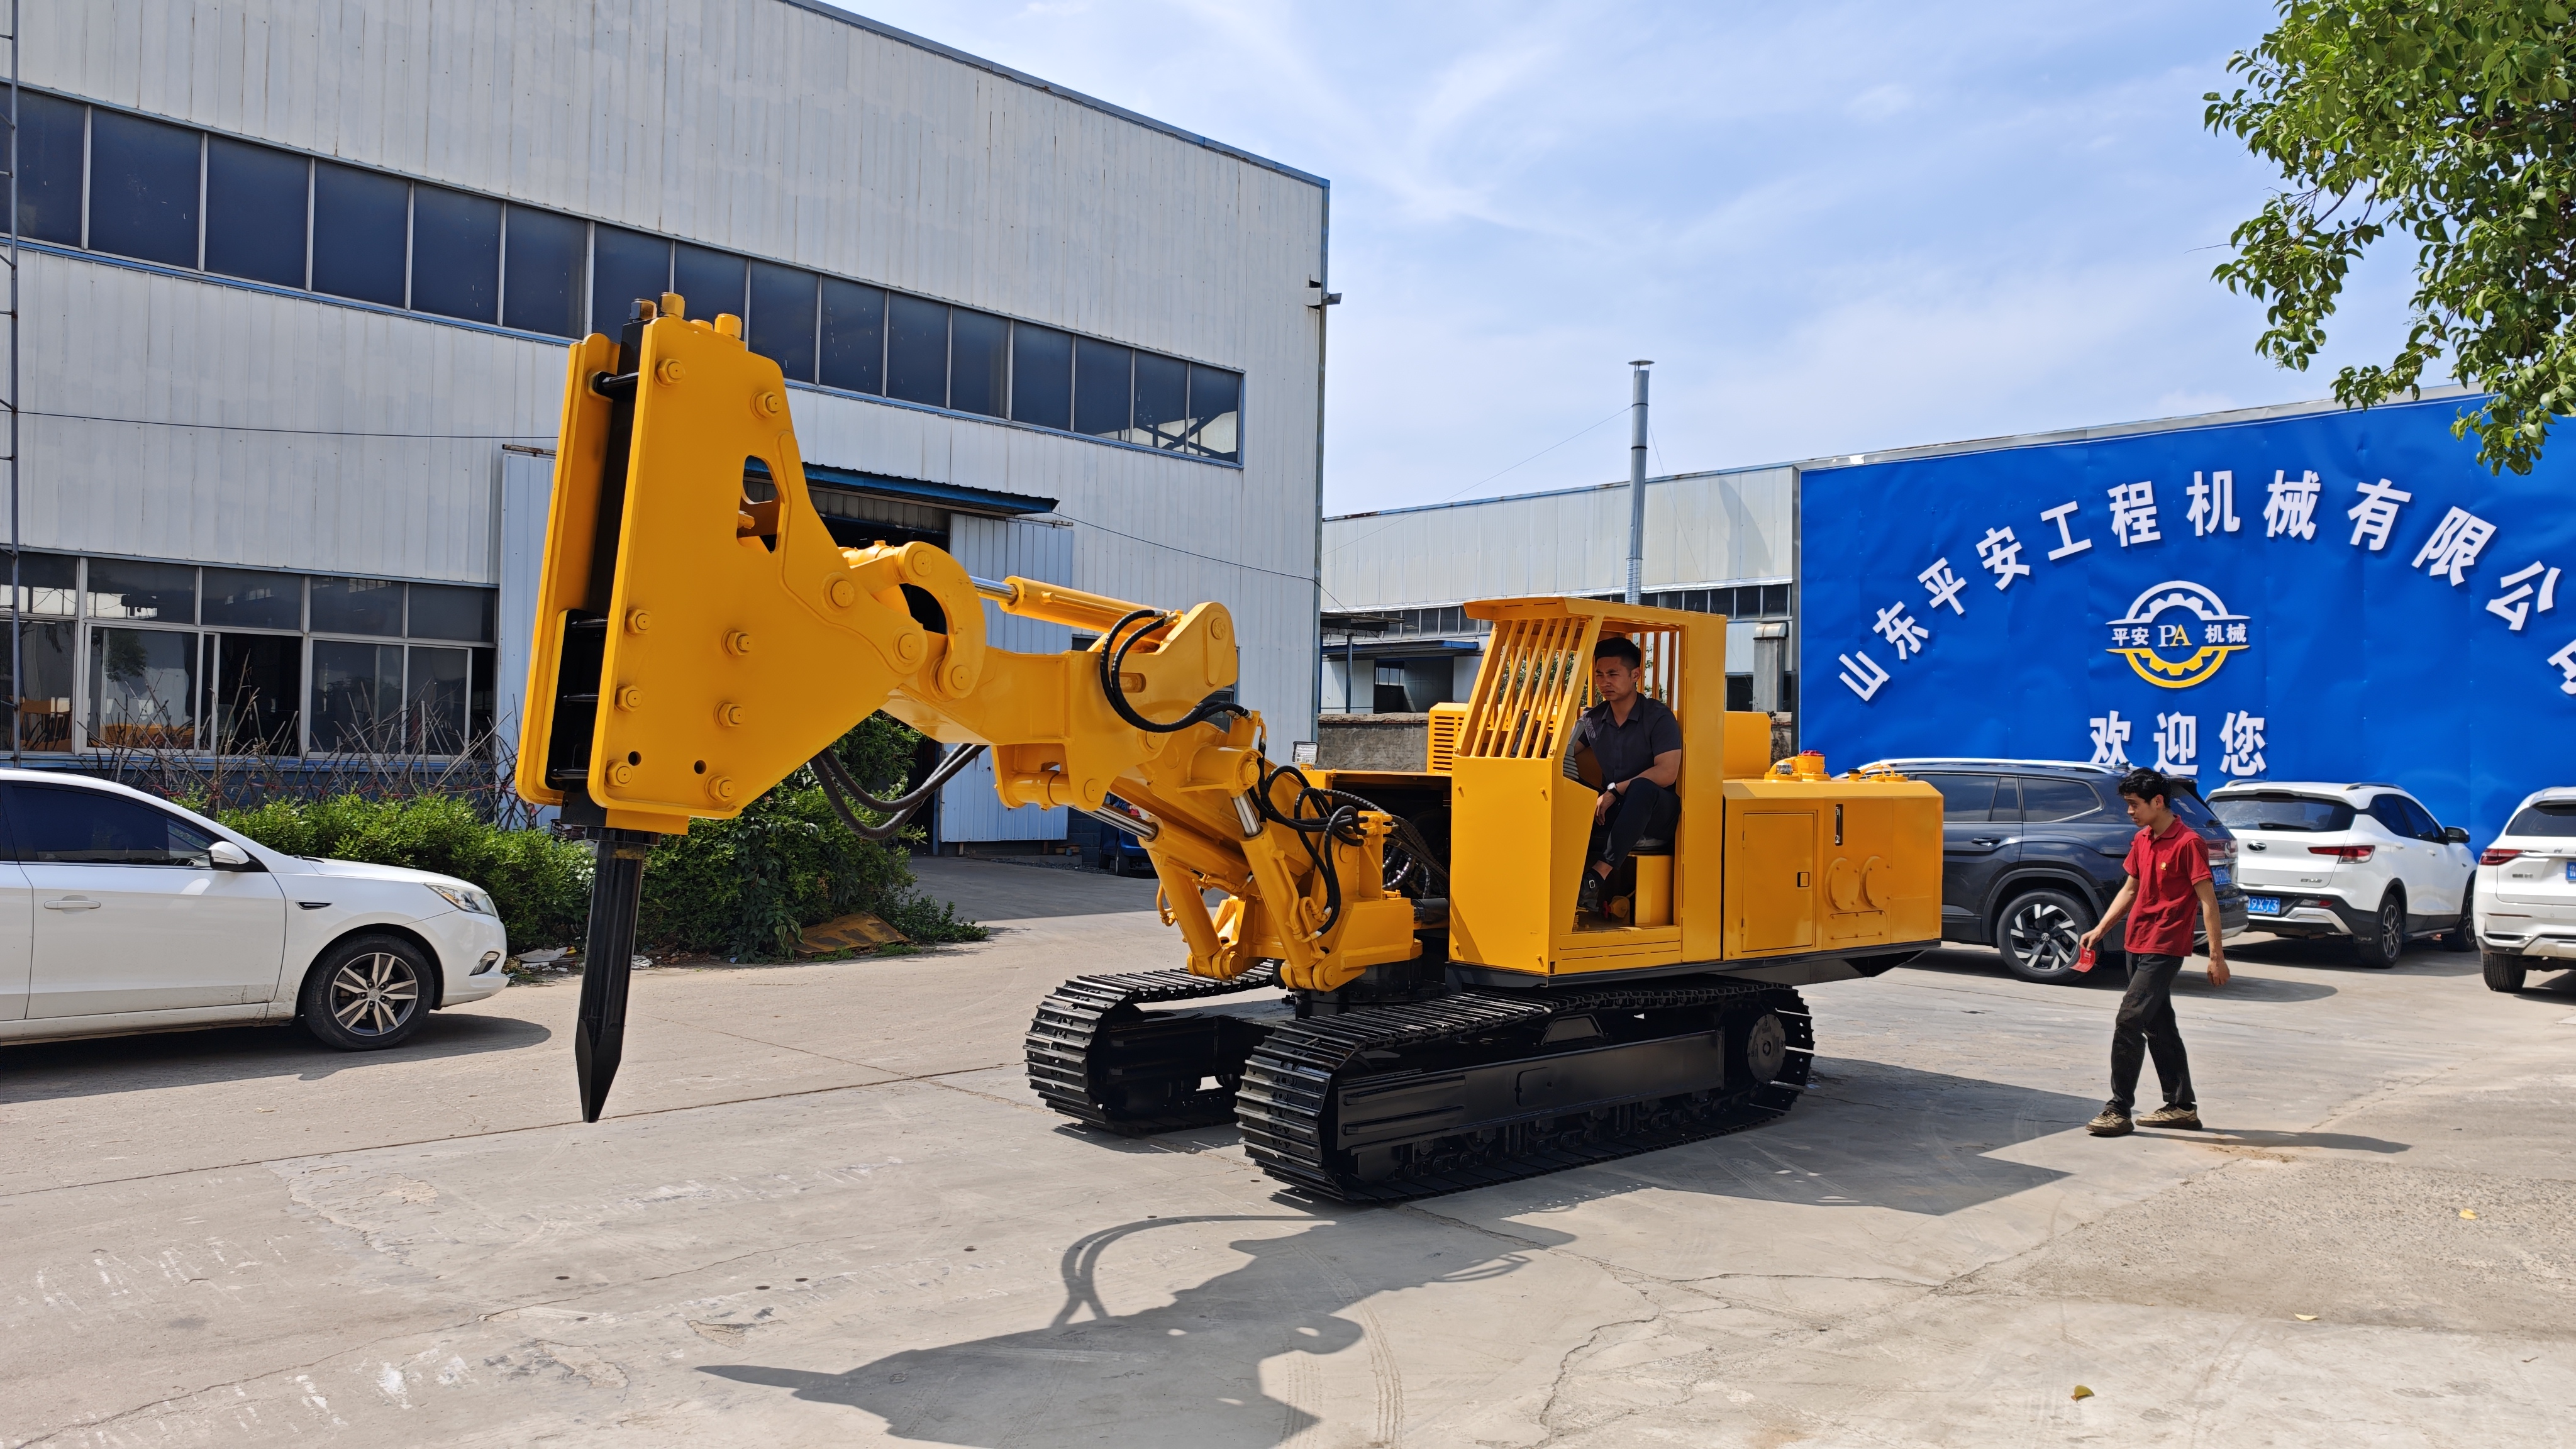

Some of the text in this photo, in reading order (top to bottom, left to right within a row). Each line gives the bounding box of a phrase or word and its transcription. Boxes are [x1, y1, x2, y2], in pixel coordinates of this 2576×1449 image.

[2112, 623, 2247, 647] 平安 PA 机械
[2089, 709, 2267, 777] 欢迎您
